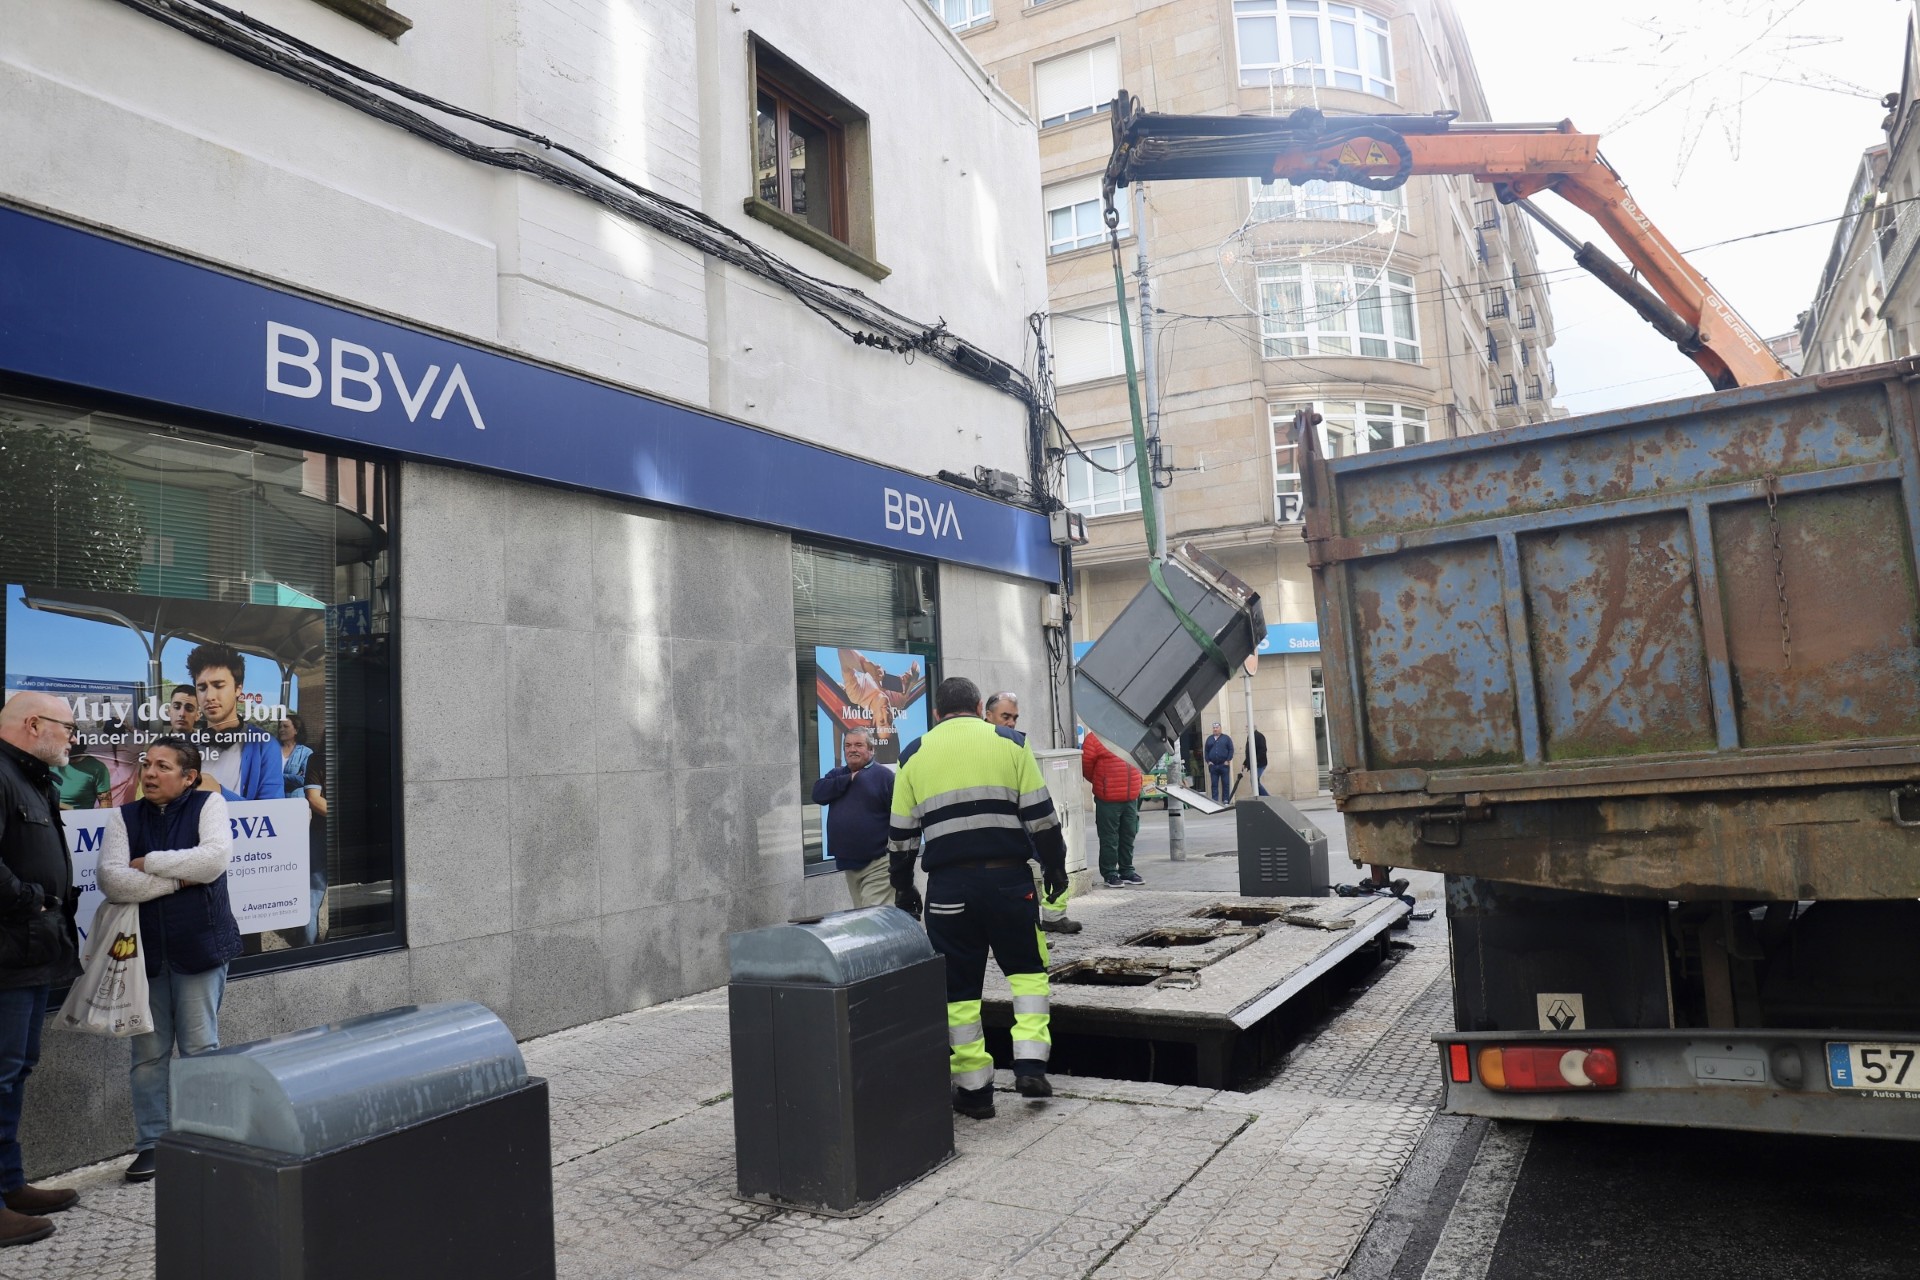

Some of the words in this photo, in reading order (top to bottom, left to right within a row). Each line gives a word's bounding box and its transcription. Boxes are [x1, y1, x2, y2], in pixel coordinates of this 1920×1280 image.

[1706, 294, 1761, 355] GUERRA
[266, 320, 486, 430] BBVA
[884, 487, 963, 541] BBVA
[76, 729, 129, 746] hacer
[190, 729, 211, 744] de
[214, 728, 271, 743] camino
[243, 851, 273, 862] datos
[235, 866, 256, 878] ojos
[258, 861, 298, 874] mirando
[242, 897, 298, 911] ¿Avanzamos?
[1837, 1069, 1847, 1079] E
[1861, 1048, 1915, 1085] 57
[1872, 1090, 1902, 1099] Autos
